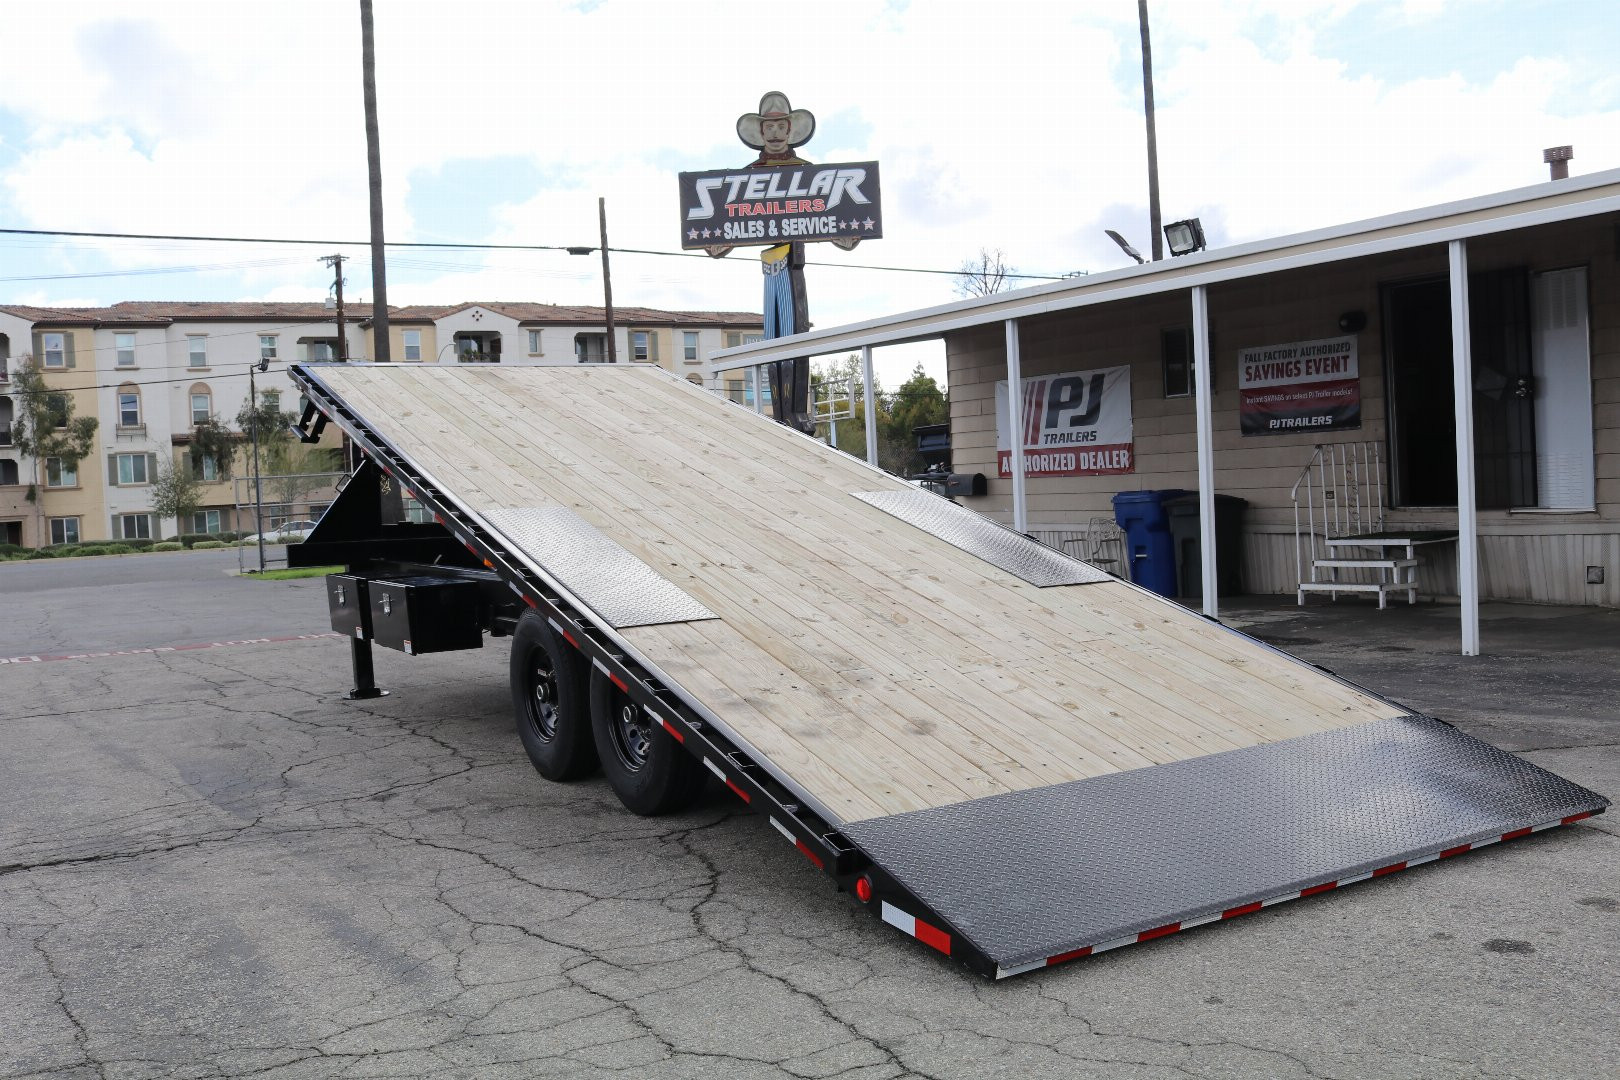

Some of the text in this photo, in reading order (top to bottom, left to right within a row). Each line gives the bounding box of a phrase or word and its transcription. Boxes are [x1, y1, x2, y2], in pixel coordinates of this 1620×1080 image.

[687, 168, 872, 221] STELLAR
[725, 199, 826, 217] TRAILERS
[723, 216, 838, 239] SALES & SERVICE
[1244, 342, 1351, 363] FALL FACTORY AUTHORIZED
[1245, 355, 1350, 382] SAVINGS EVENT
[1045, 373, 1106, 429] PJ
[1043, 430, 1098, 445] TRAILERS
[1002, 450, 1130, 473] AHORIZED DEALER
